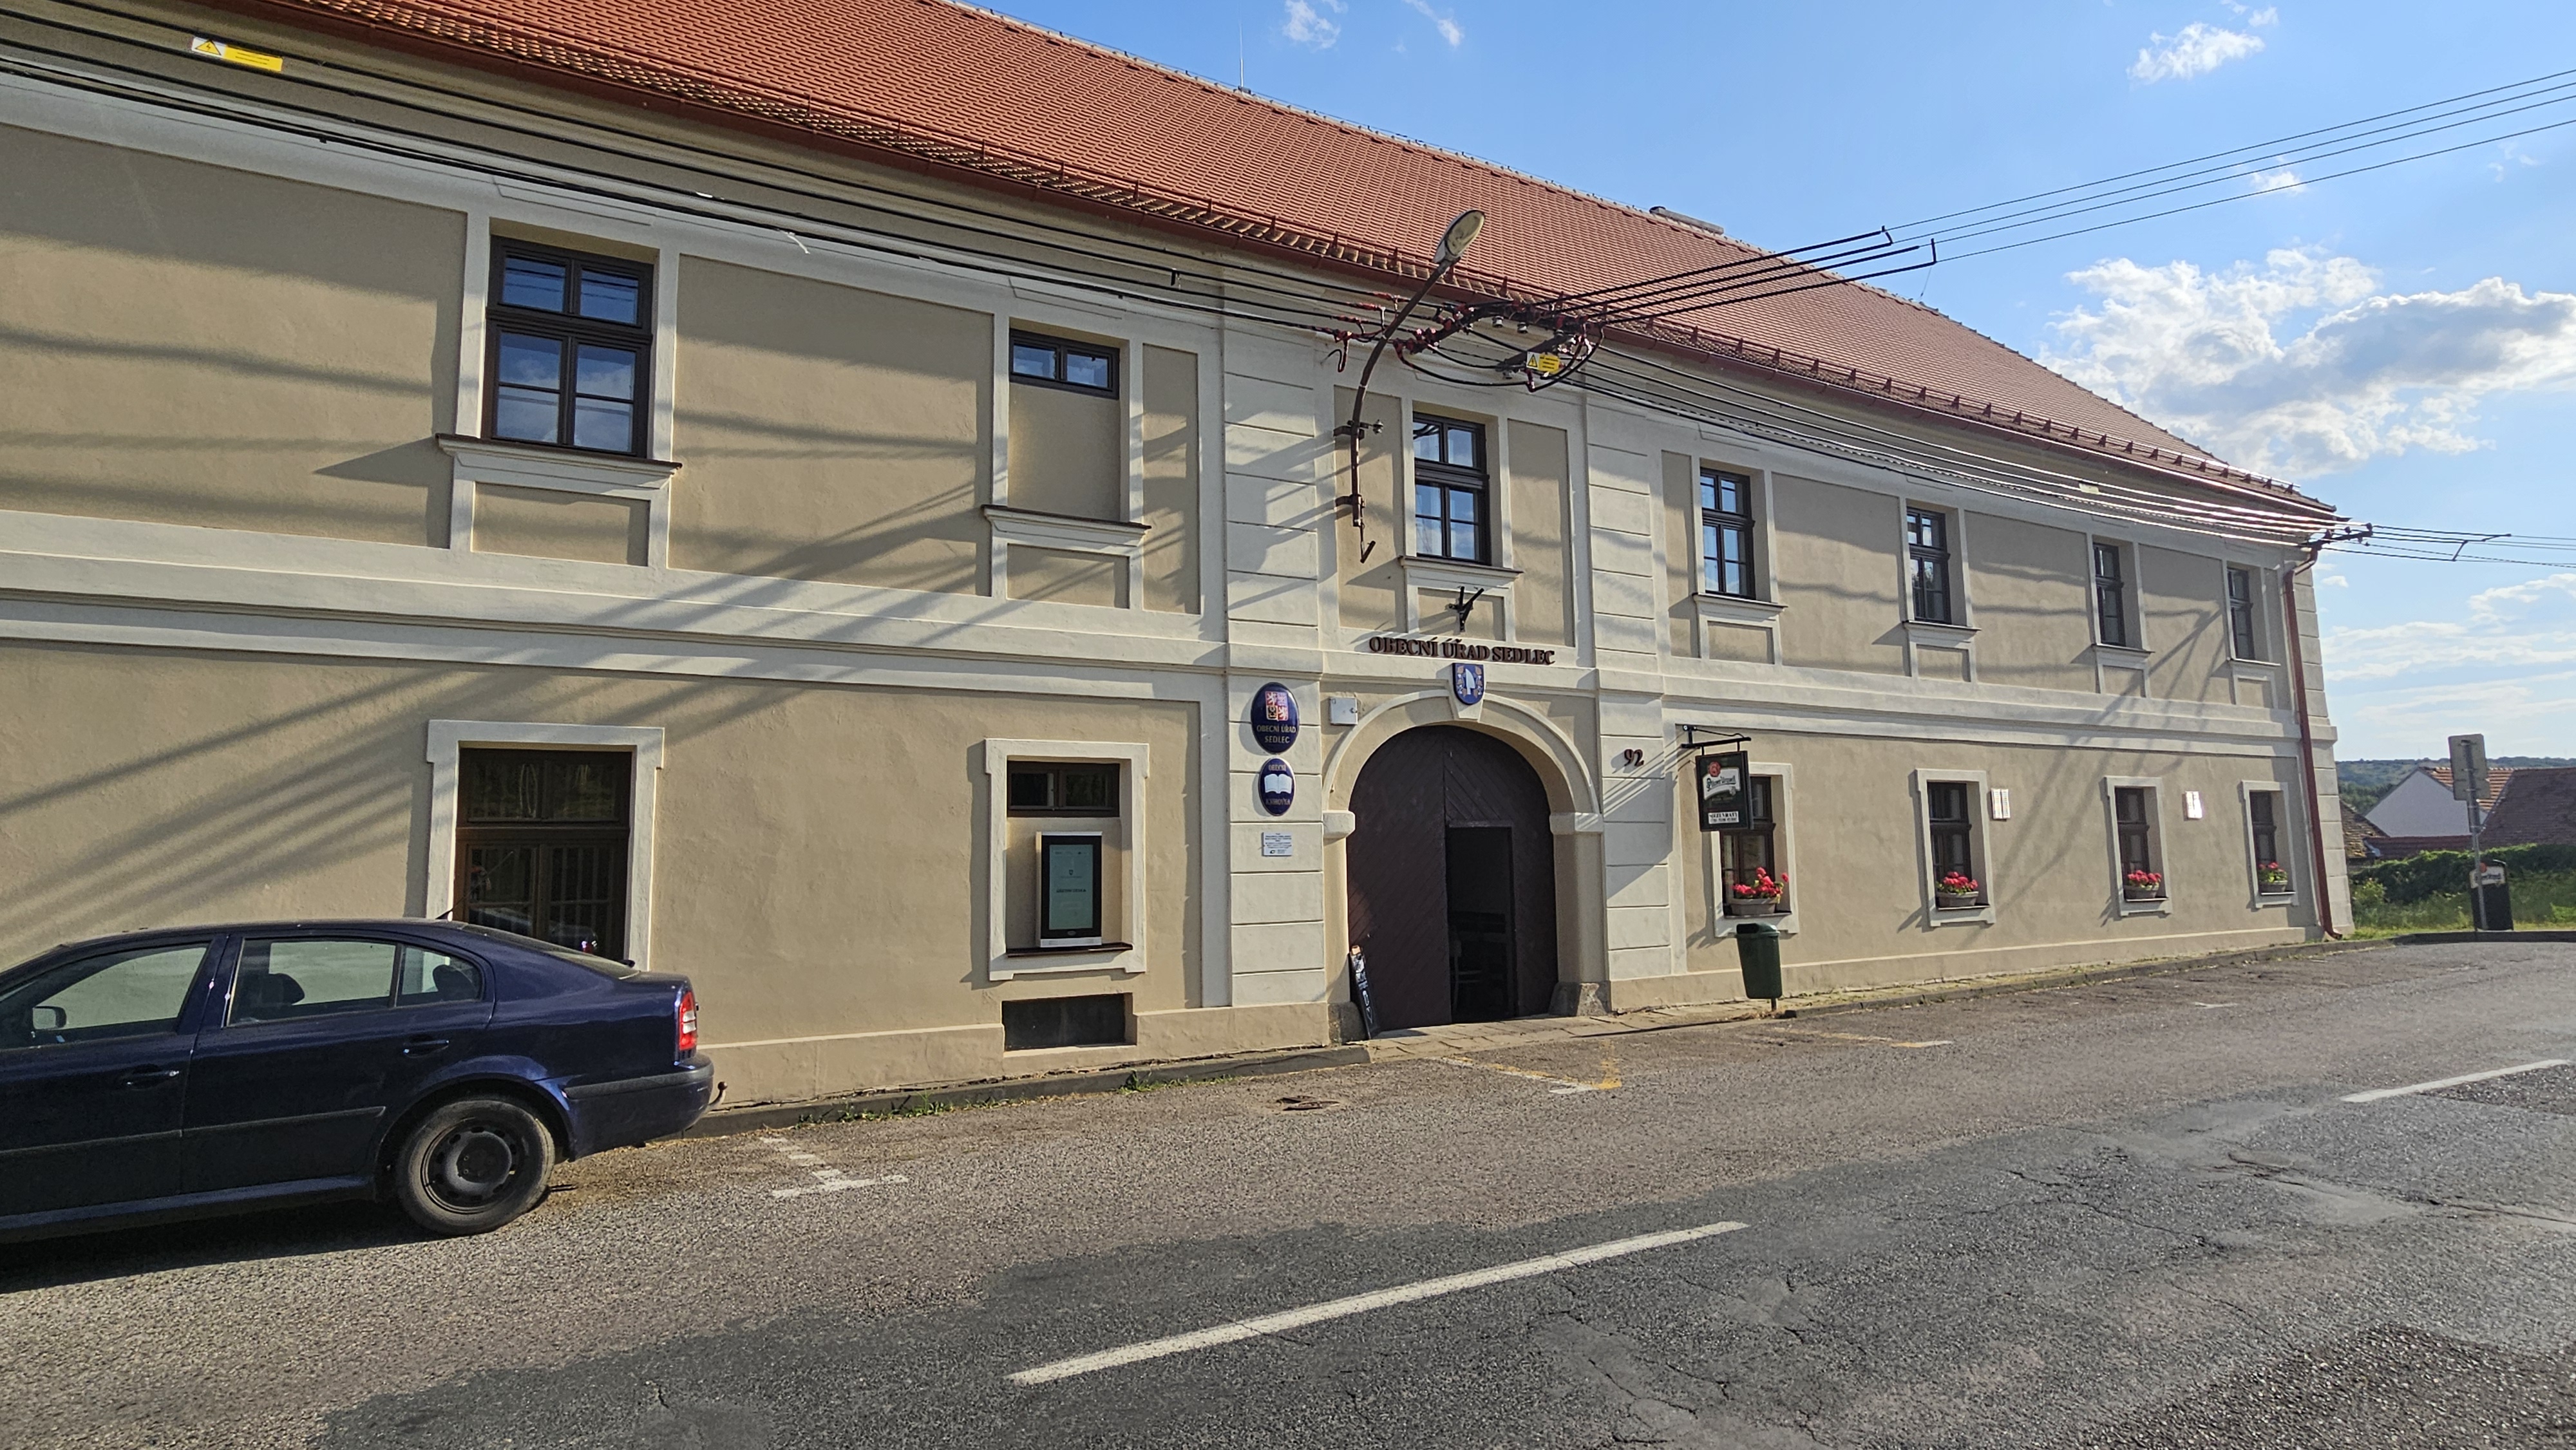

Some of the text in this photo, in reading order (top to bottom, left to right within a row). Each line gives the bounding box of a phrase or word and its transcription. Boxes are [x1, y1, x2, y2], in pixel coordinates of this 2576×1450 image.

[1369, 636, 1555, 665] OBECNÍ ÚŘAD SEDLEC
[1265, 735, 1290, 744] SEDLEC
[1624, 748, 1644, 767] 92
